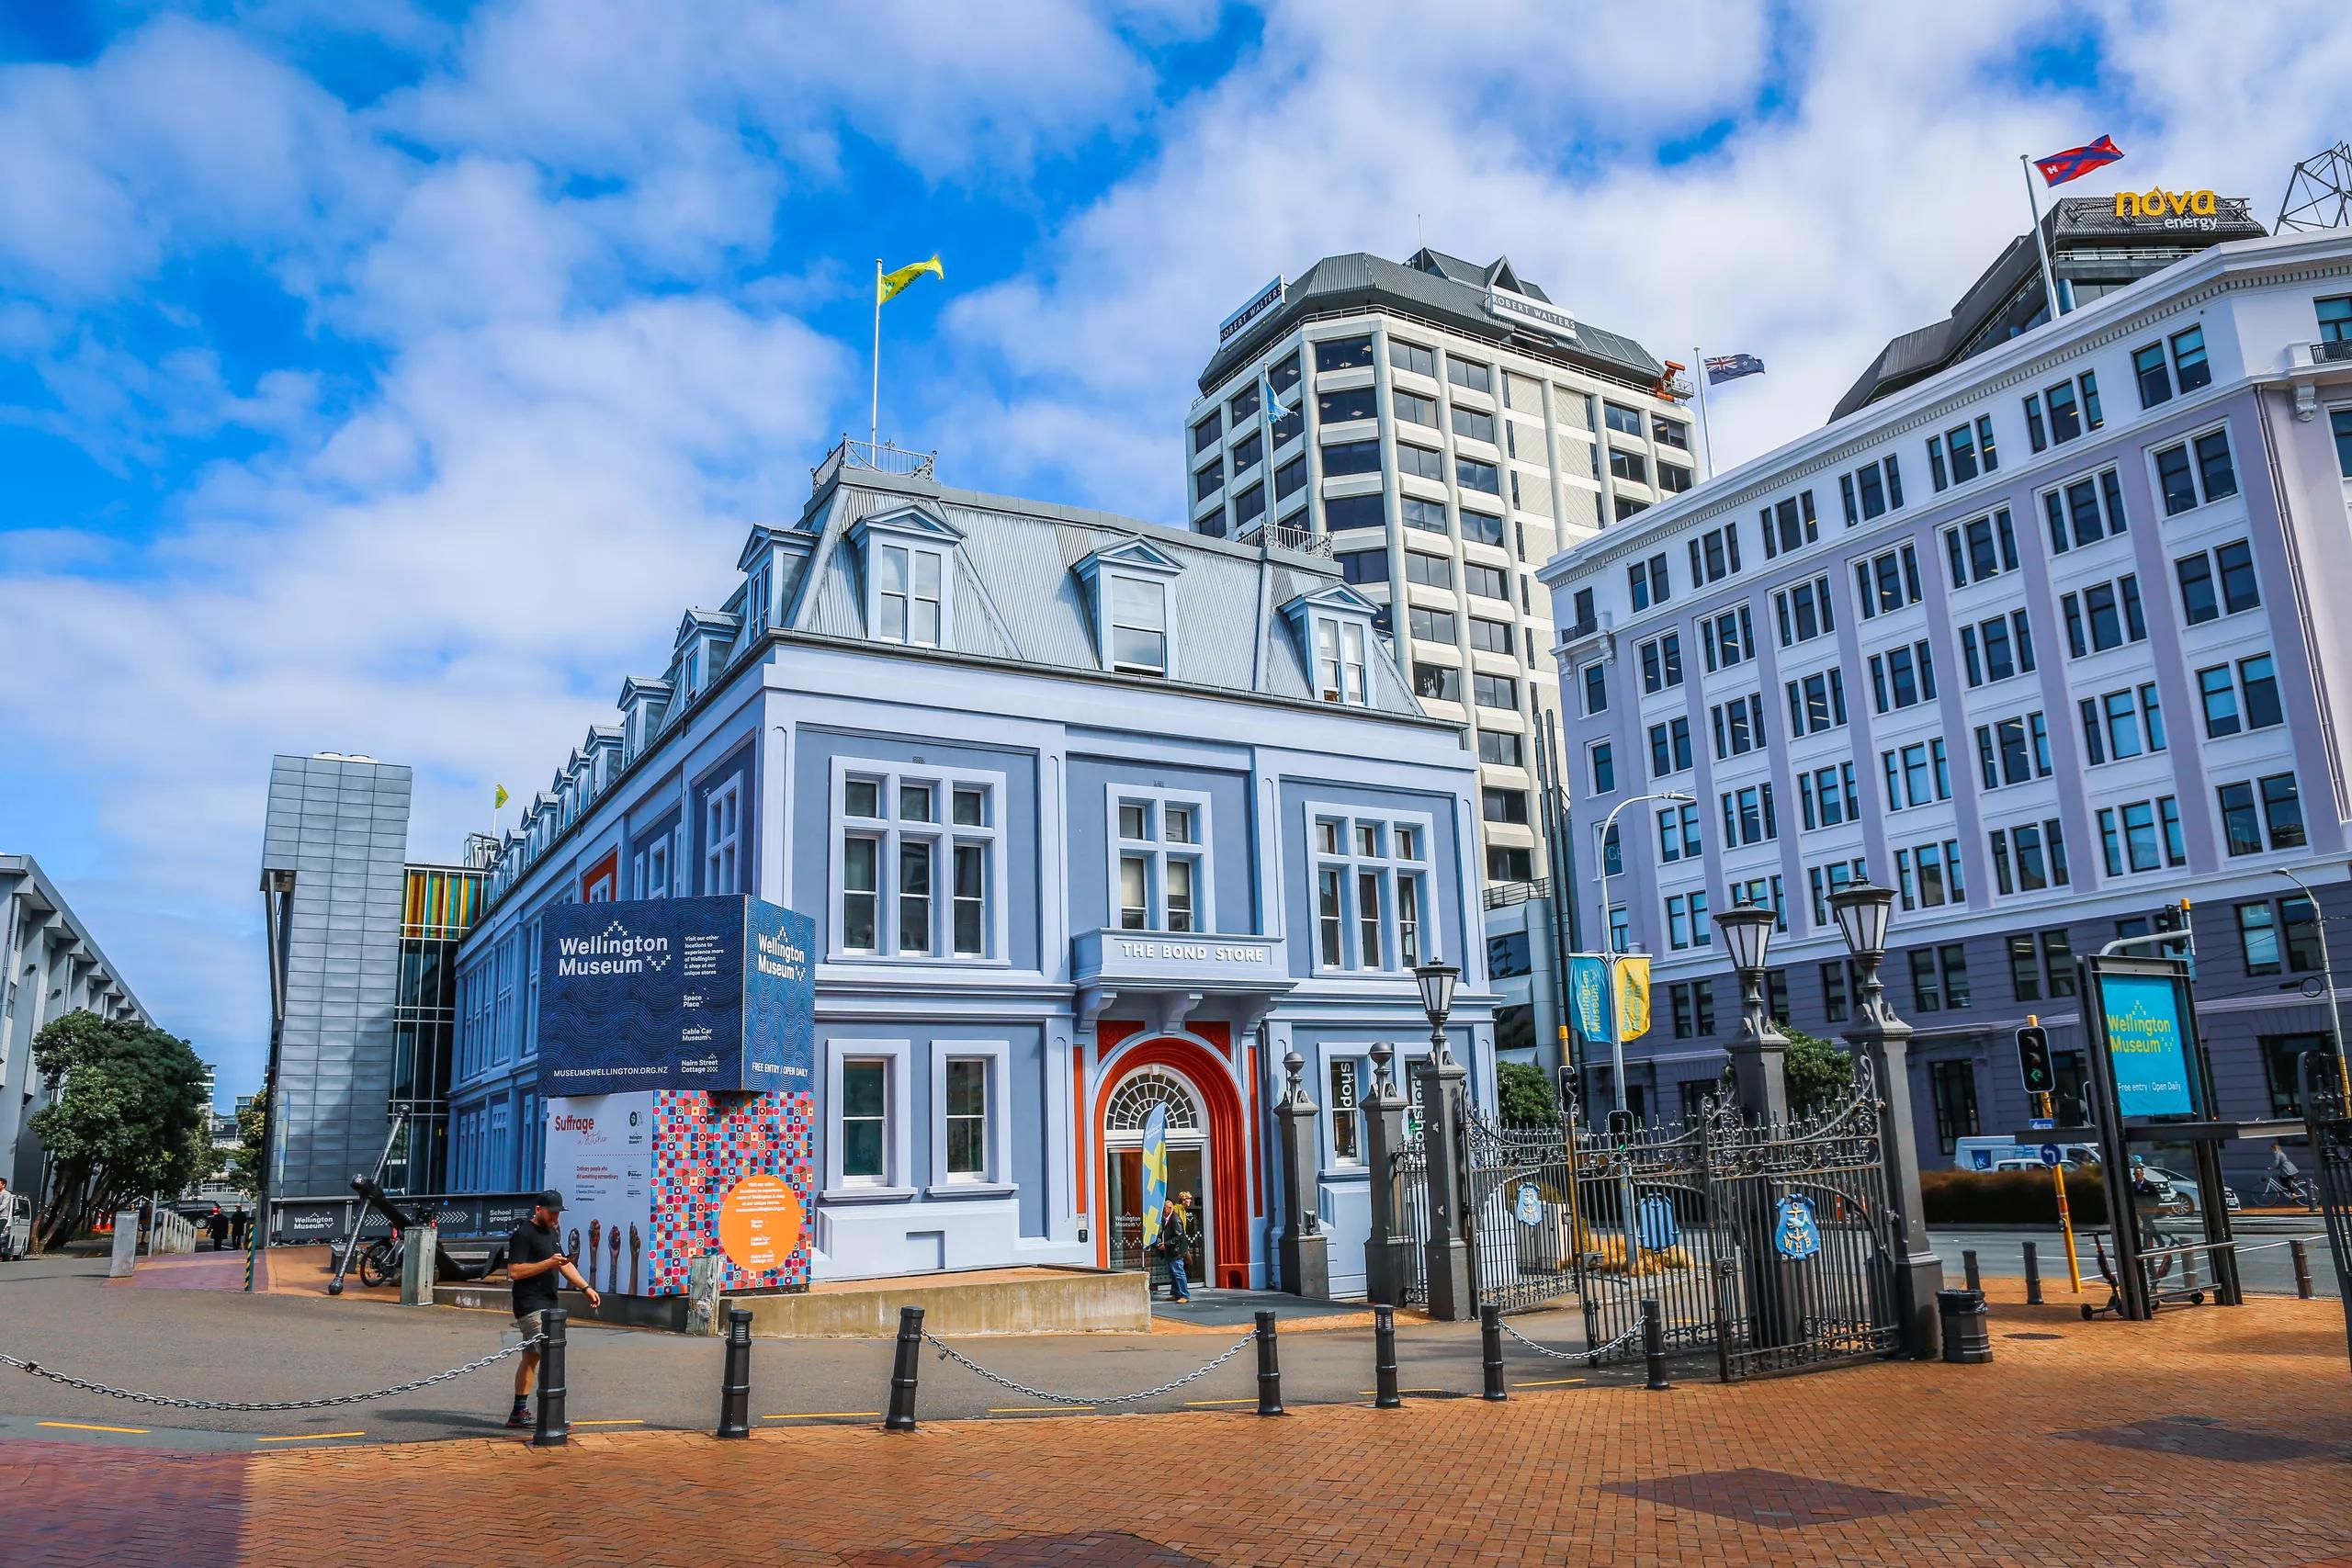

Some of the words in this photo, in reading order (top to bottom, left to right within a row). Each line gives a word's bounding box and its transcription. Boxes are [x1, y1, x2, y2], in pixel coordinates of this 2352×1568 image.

[2115, 186, 2218, 217] nova
[2164, 217, 2218, 231] energy
[1220, 313, 1248, 340] ROBERT
[1250, 285, 1282, 317] WALTERS
[1492, 295, 1530, 314] ROBERT
[1533, 309, 1576, 329] WALTERS
[560, 935, 668, 957] Wellington
[758, 932, 805, 964] Wellington
[1122, 942, 1155, 958] THE
[1161, 945, 1207, 960] BOND
[1215, 947, 1263, 963] STORE
[559, 957, 643, 976] Museum
[758, 953, 795, 980] Museum
[2106, 1013, 2171, 1036] Wellington
[2109, 1035, 2162, 1054] Museum
[553, 1066, 668, 1077] MUSEUMSWELLINGTON.ORG.NZ
[752, 1061, 763, 1072] FREE
[764, 1063, 779, 1074] ENTRY
[783, 1066, 796, 1076] OPEN
[796, 1067, 808, 1077] DAILY
[1340, 1062, 1354, 1108] shop
[2117, 1082, 2132, 1092] Free
[2132, 1082, 2148, 1093] entry
[2151, 1081, 2166, 1093] Open
[2166, 1080, 2182, 1092] Daily
[555, 1114, 594, 1134] Suffrage
